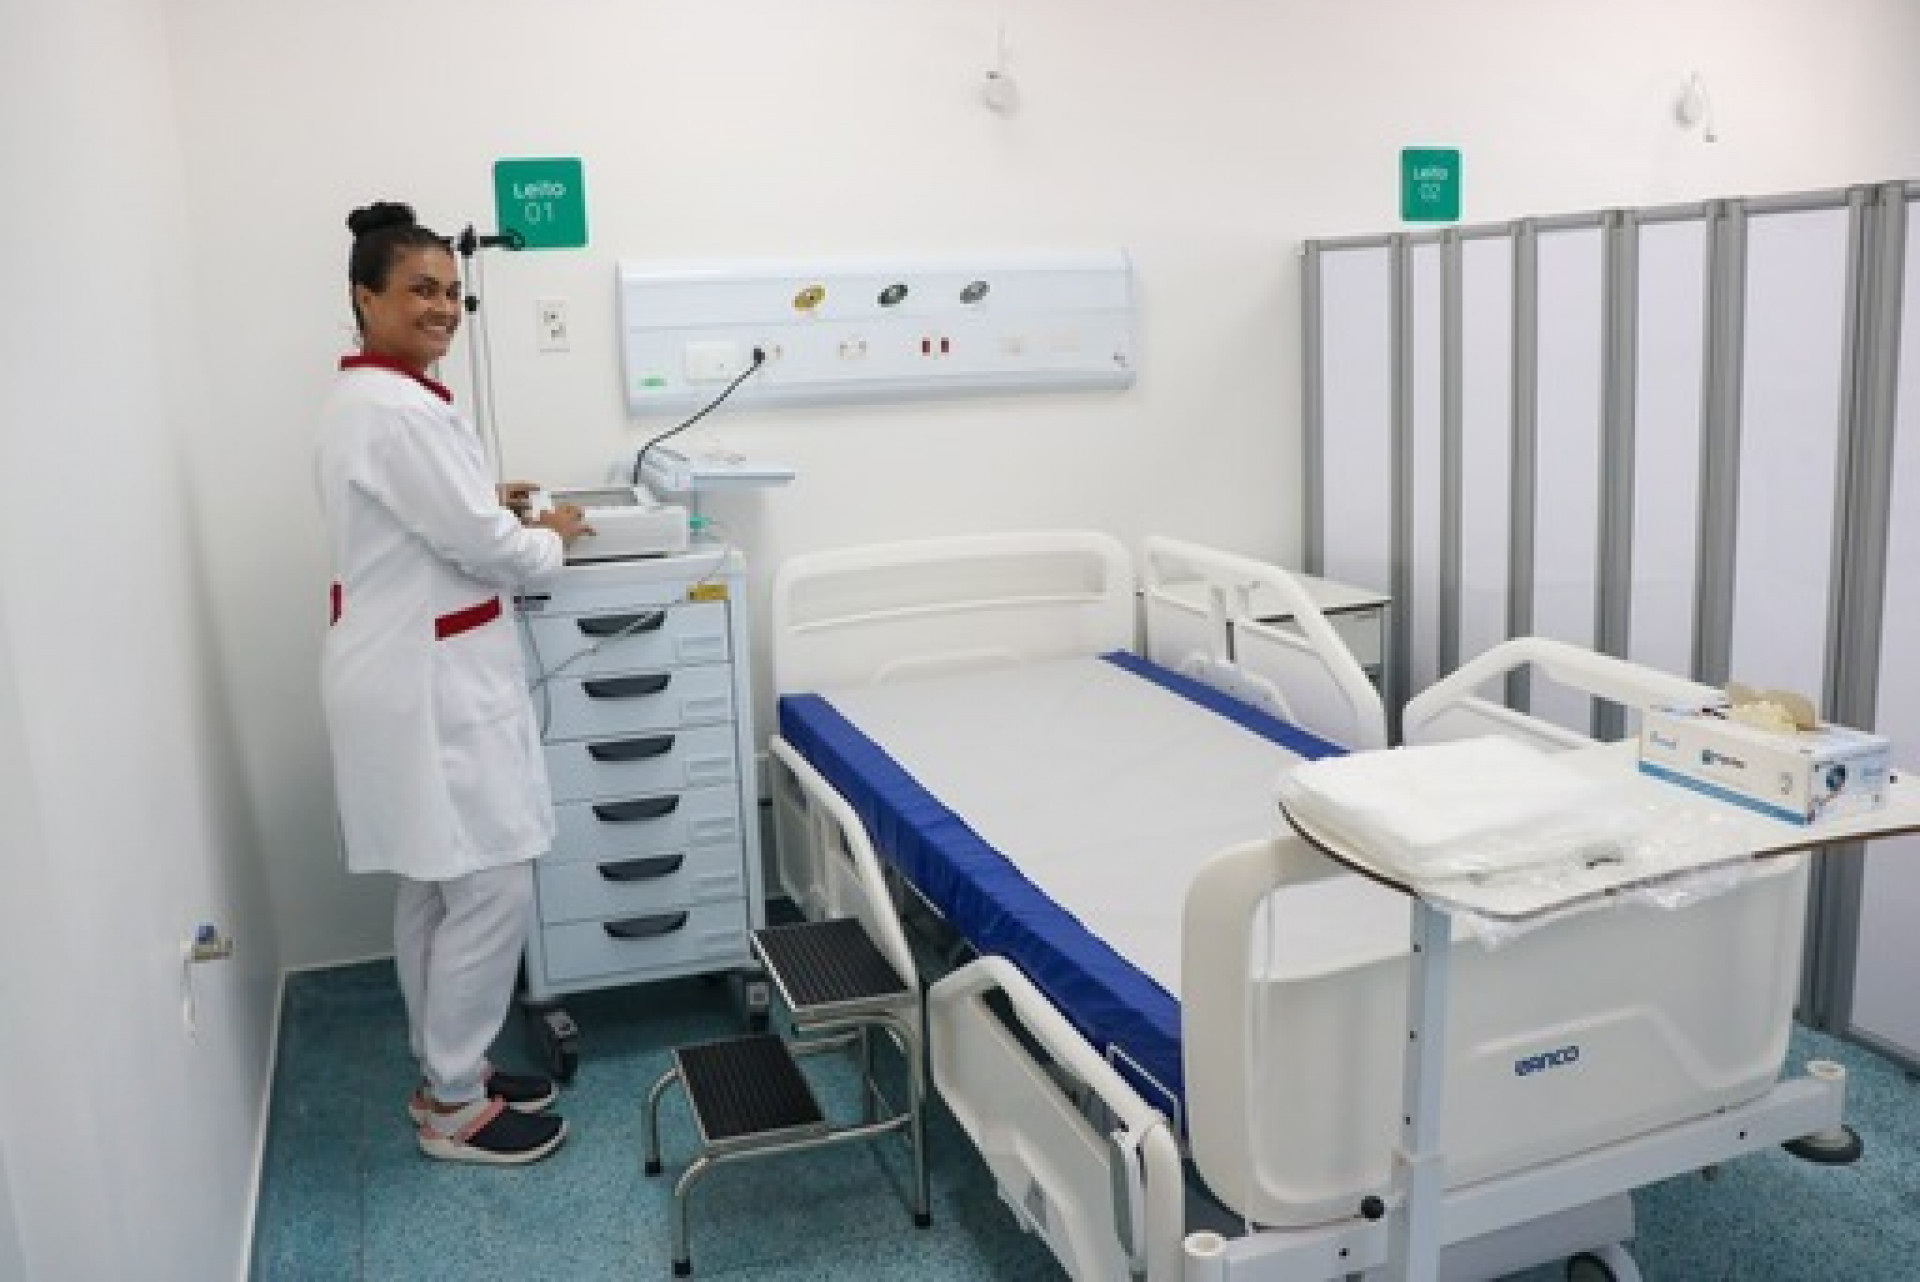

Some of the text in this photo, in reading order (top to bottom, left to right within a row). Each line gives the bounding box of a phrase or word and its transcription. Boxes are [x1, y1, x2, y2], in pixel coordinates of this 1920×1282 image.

[1413, 164, 1449, 181] Leito
[512, 180, 567, 199] Leito
[524, 201, 553, 225] 01
